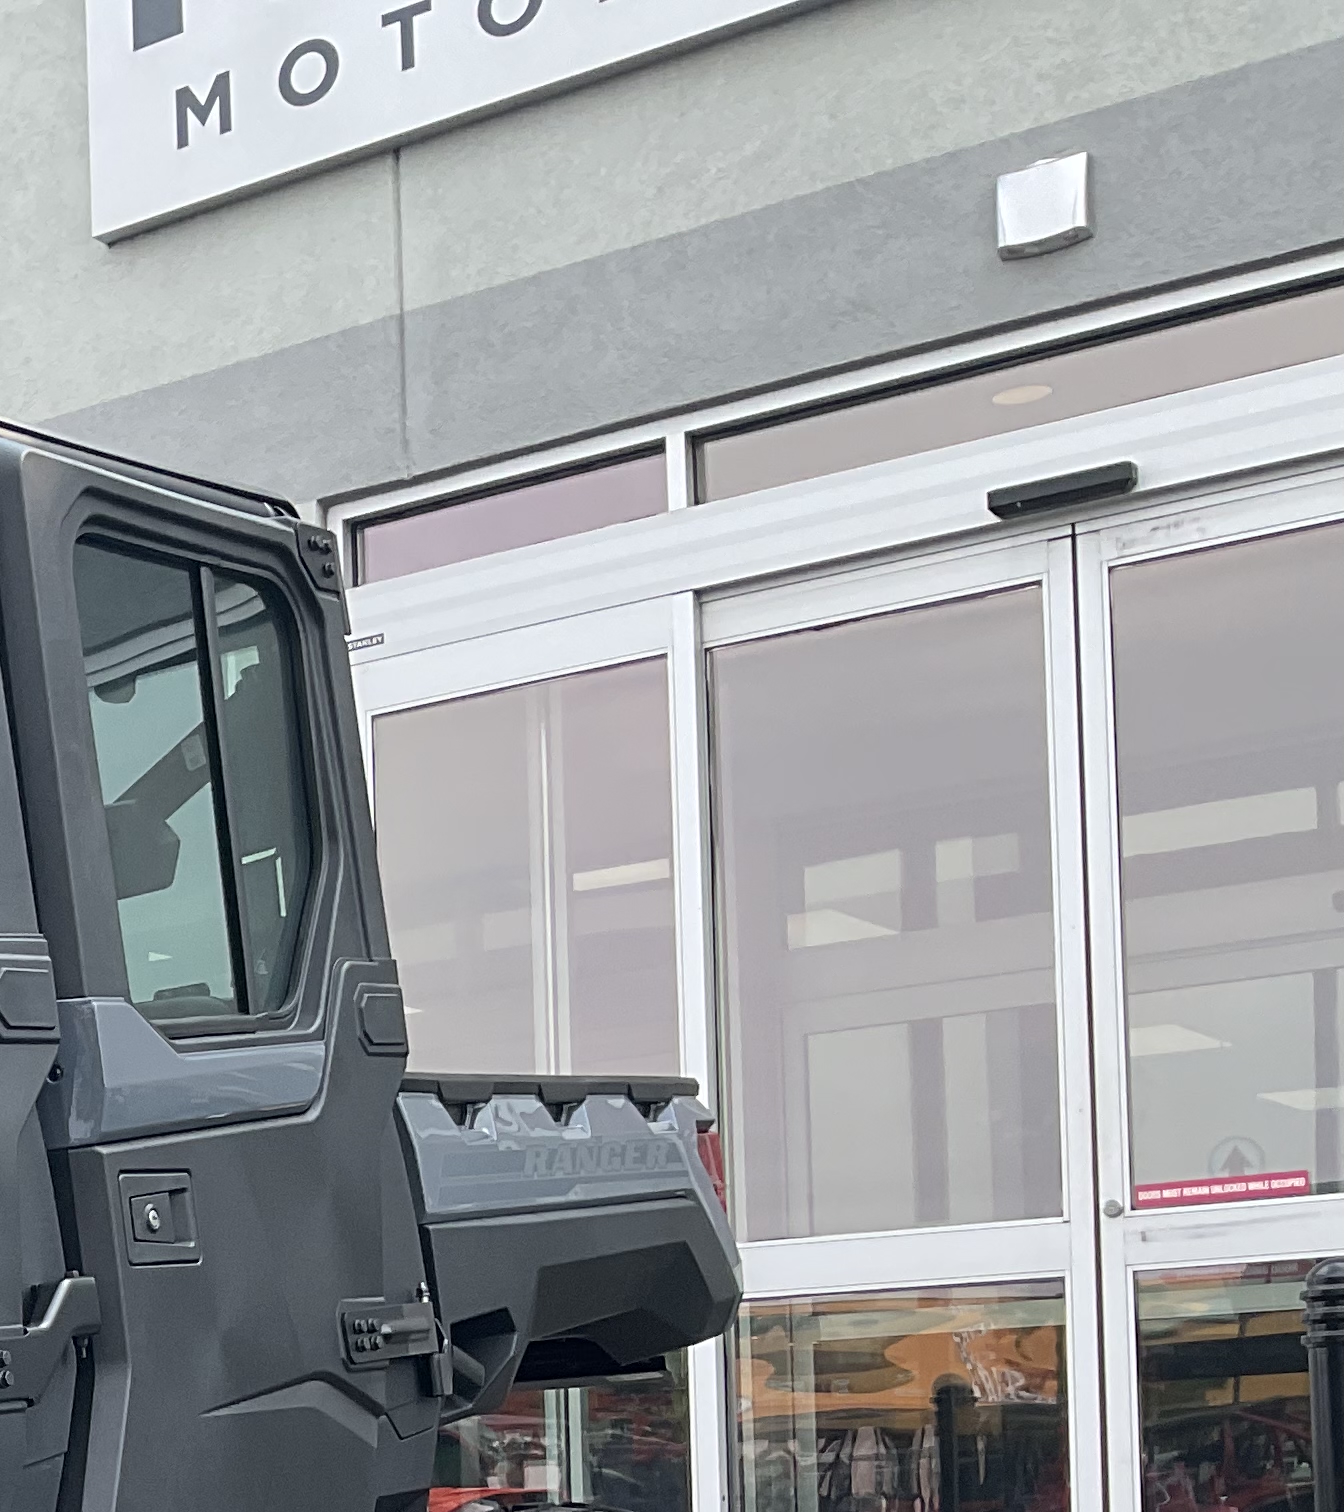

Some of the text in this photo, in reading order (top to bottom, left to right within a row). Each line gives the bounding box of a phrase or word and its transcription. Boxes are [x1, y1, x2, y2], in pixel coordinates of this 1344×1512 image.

[175, 0, 609, 149] MOTO
[348, 636, 383, 651] STANLEY
[523, 1137, 669, 1177] RANGER
